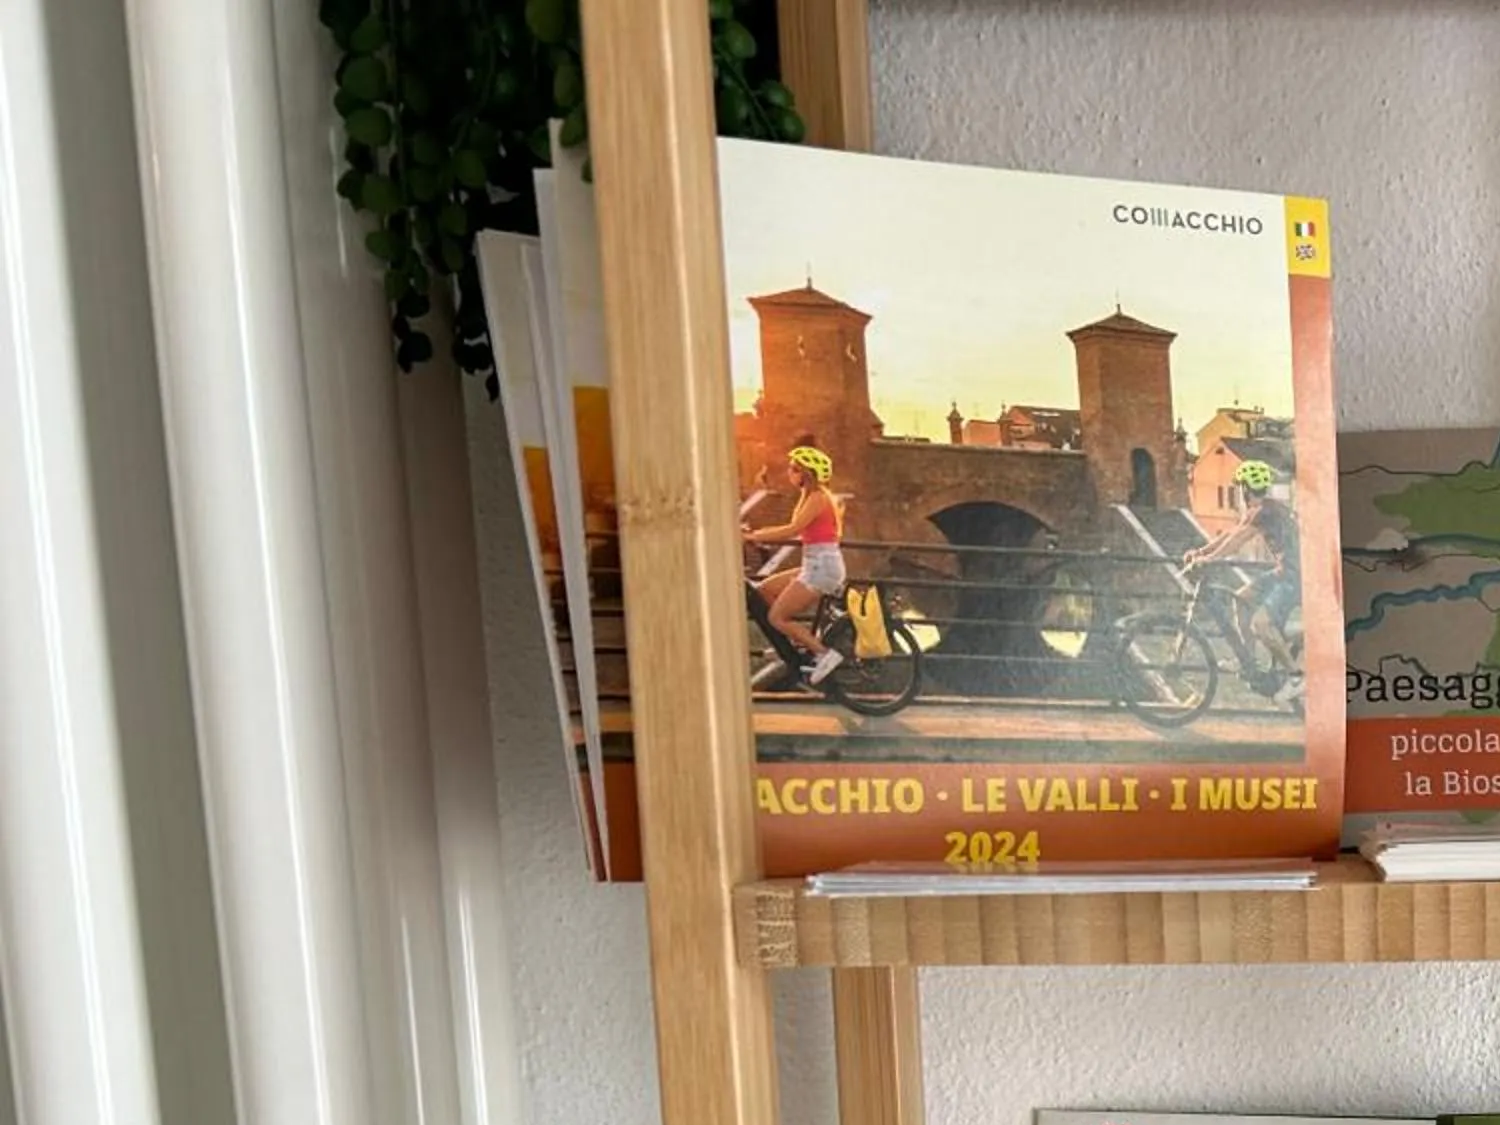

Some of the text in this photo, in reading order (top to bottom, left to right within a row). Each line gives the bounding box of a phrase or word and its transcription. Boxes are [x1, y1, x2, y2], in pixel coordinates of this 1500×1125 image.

[1391, 728, 1500, 760] piccola
[962, 778, 1007, 813] LE
[1018, 778, 1139, 812] VALLI
[1171, 778, 1187, 810] I
[1199, 777, 1318, 810] MUSEI
[1404, 771, 1432, 796] la
[945, 830, 1040, 865] 2024
